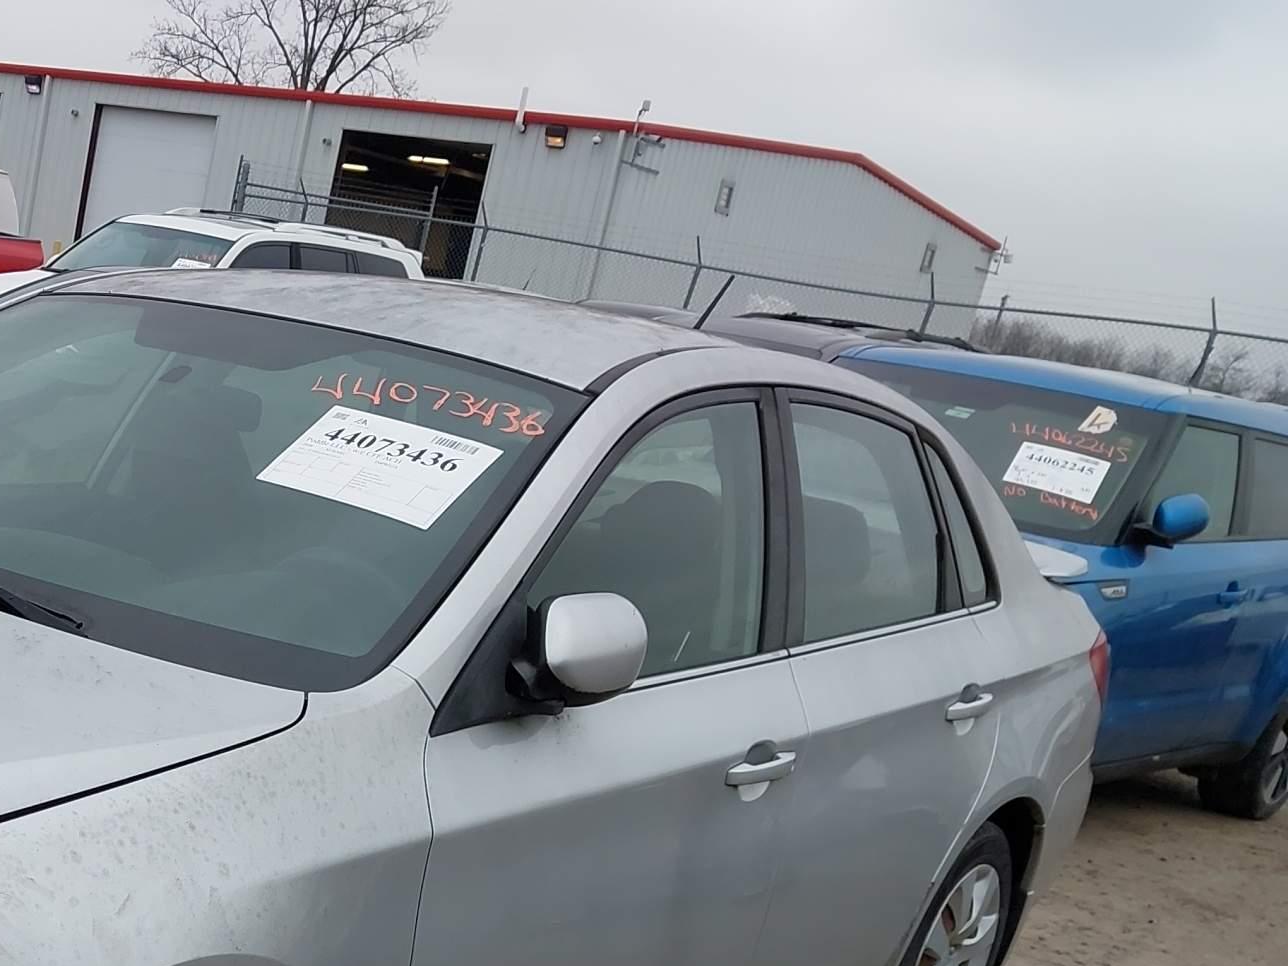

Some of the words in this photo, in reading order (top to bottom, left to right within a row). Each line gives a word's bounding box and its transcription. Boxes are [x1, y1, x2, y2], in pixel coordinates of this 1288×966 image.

[312, 373, 545, 437] 44073436
[324, 427, 464, 473] 44073436
[1026, 453, 1096, 476] 44062245
